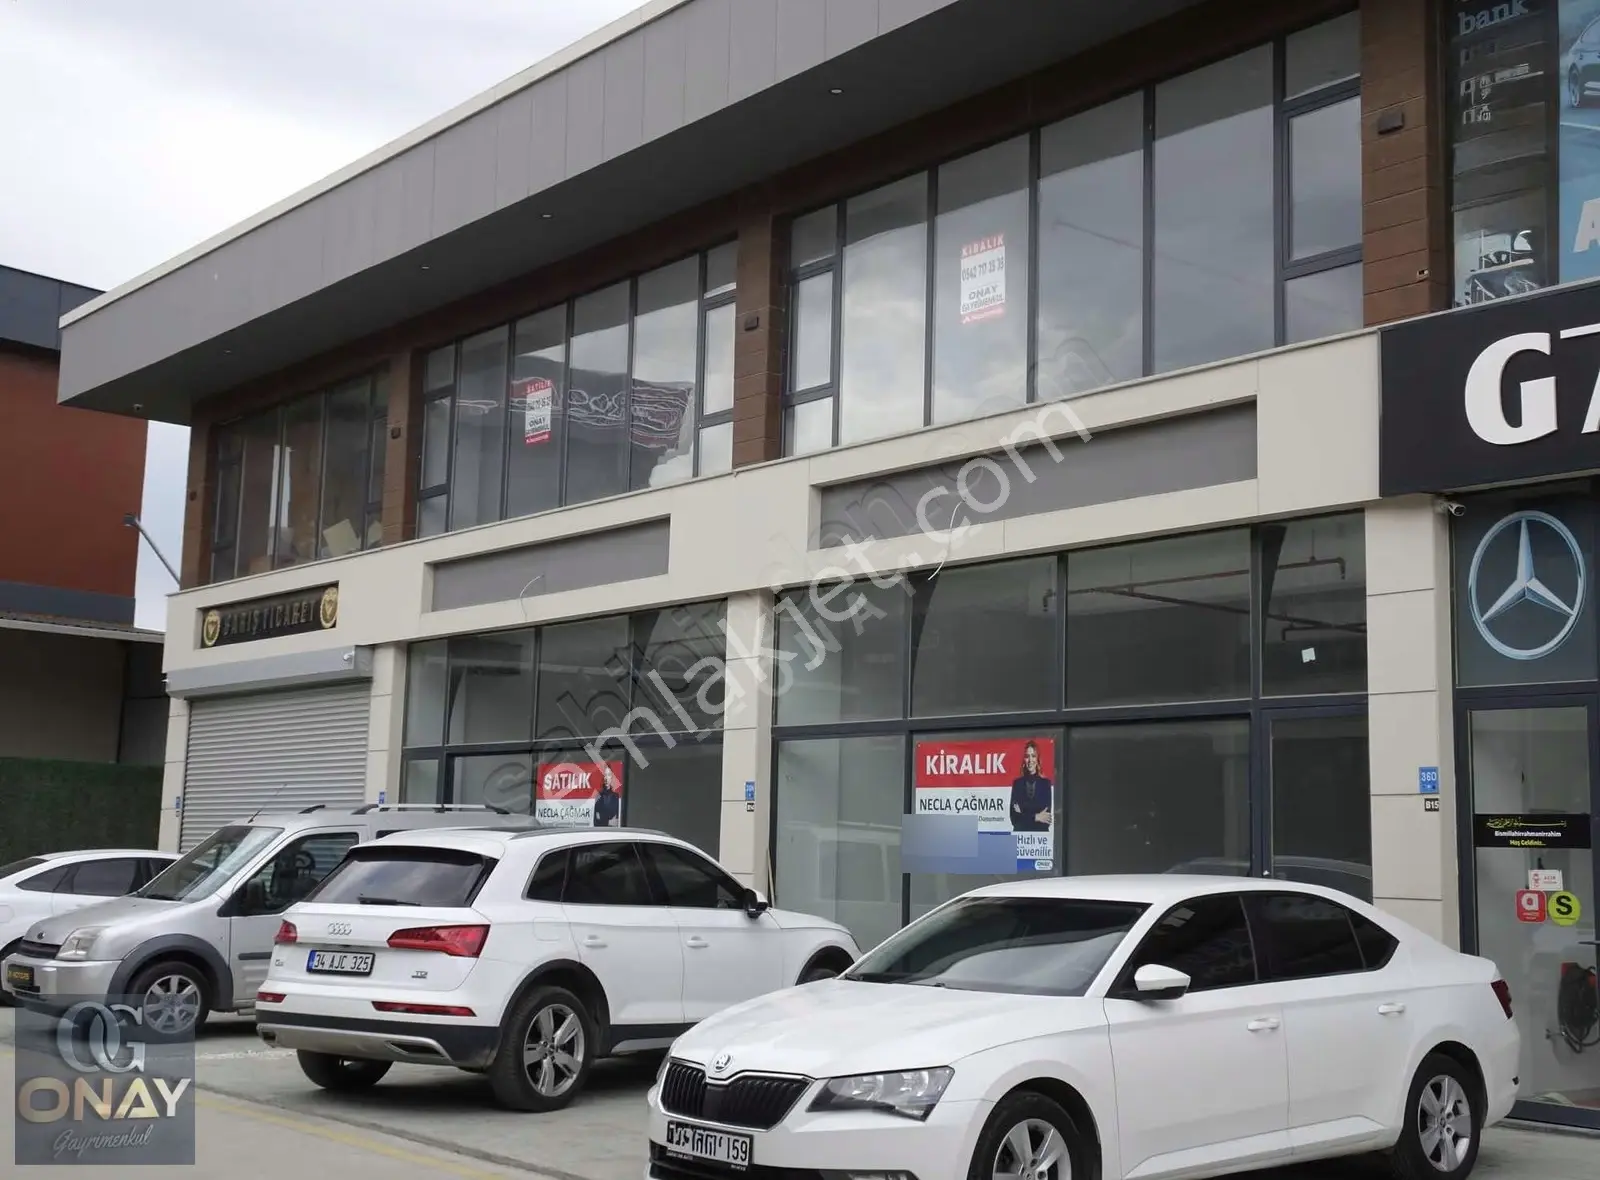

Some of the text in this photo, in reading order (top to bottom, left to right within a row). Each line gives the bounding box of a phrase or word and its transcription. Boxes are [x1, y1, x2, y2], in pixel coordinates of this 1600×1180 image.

[1459, 0, 1529, 35] bank
[968, 284, 998, 300] ONAY
[926, 749, 1006, 775] KİRALIK
[544, 772, 592, 790] SATILIK
[1421, 772, 1437, 782] 360
[538, 805, 590, 820] NECLA ÇAĞMAR
[920, 796, 1004, 813] NECLA ÇAĞMAR
[1038, 837, 1048, 845] ve
[314, 954, 370, 971] 34 AJC 325
